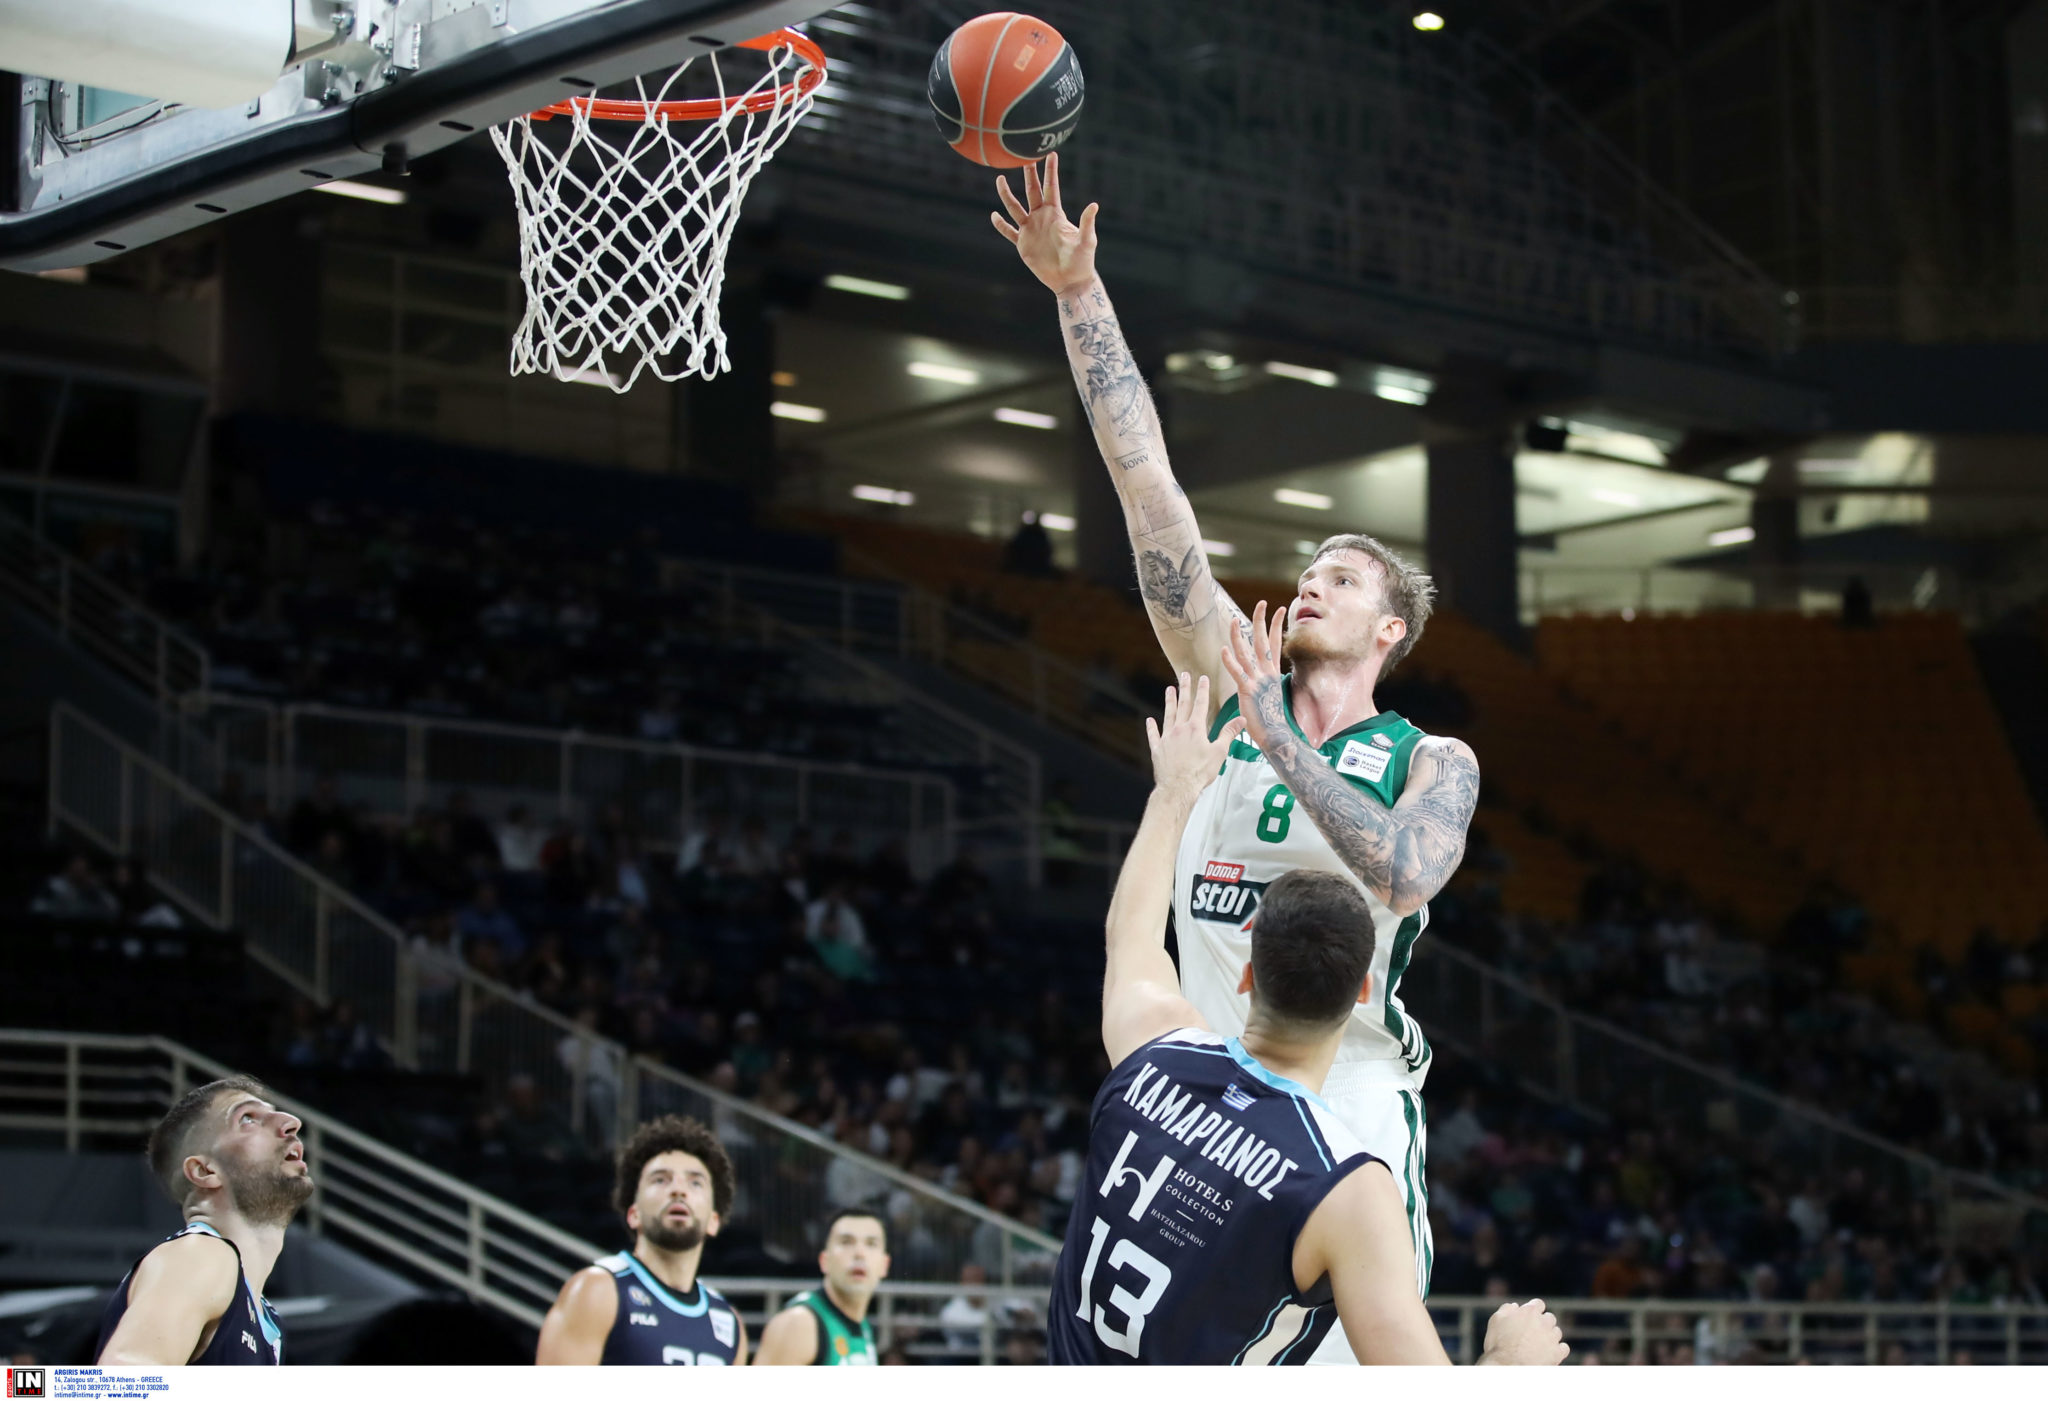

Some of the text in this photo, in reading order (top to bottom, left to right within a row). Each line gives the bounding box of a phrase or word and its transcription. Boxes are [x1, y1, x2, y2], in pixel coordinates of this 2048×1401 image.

[1256, 784, 1295, 843] 8
[1165, 1184, 1225, 1226] COLLECTION
[1173, 1167, 1234, 1212] HOTELS
[1150, 1208, 1207, 1248] HATZILAZAROU
[1159, 1228, 1186, 1248] GROUP
[1076, 1215, 1172, 1358] 13
[629, 1311, 658, 1327] FILA
